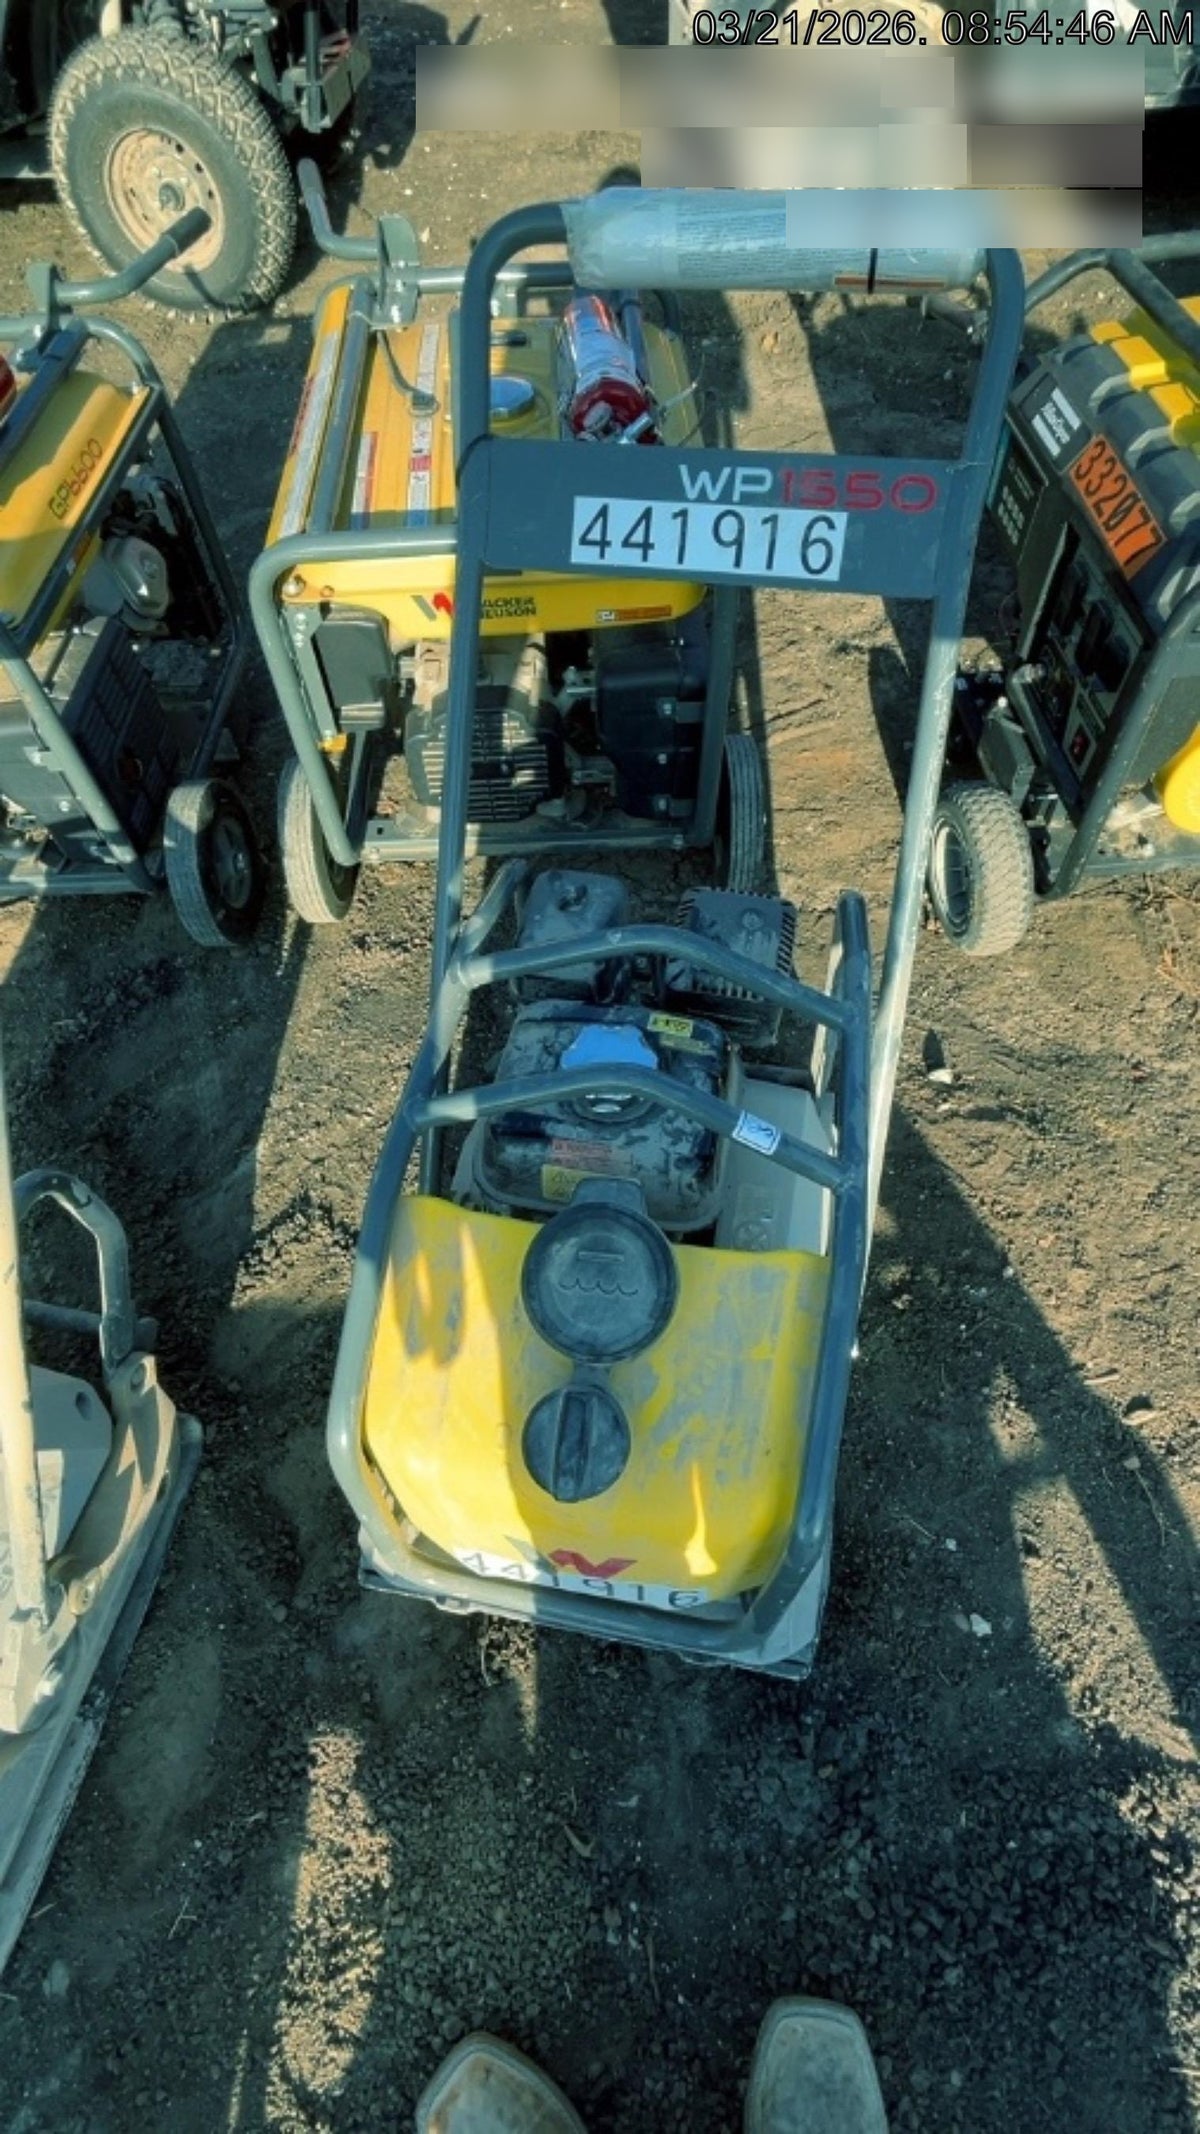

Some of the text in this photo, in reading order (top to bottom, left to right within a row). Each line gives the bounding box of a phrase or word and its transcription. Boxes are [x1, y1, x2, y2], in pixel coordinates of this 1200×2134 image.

[678, 463, 938, 514] WP1550
[1074, 440, 1164, 567] 332077
[578, 502, 837, 576] 441916
[482, 597, 536, 609] ACKER
